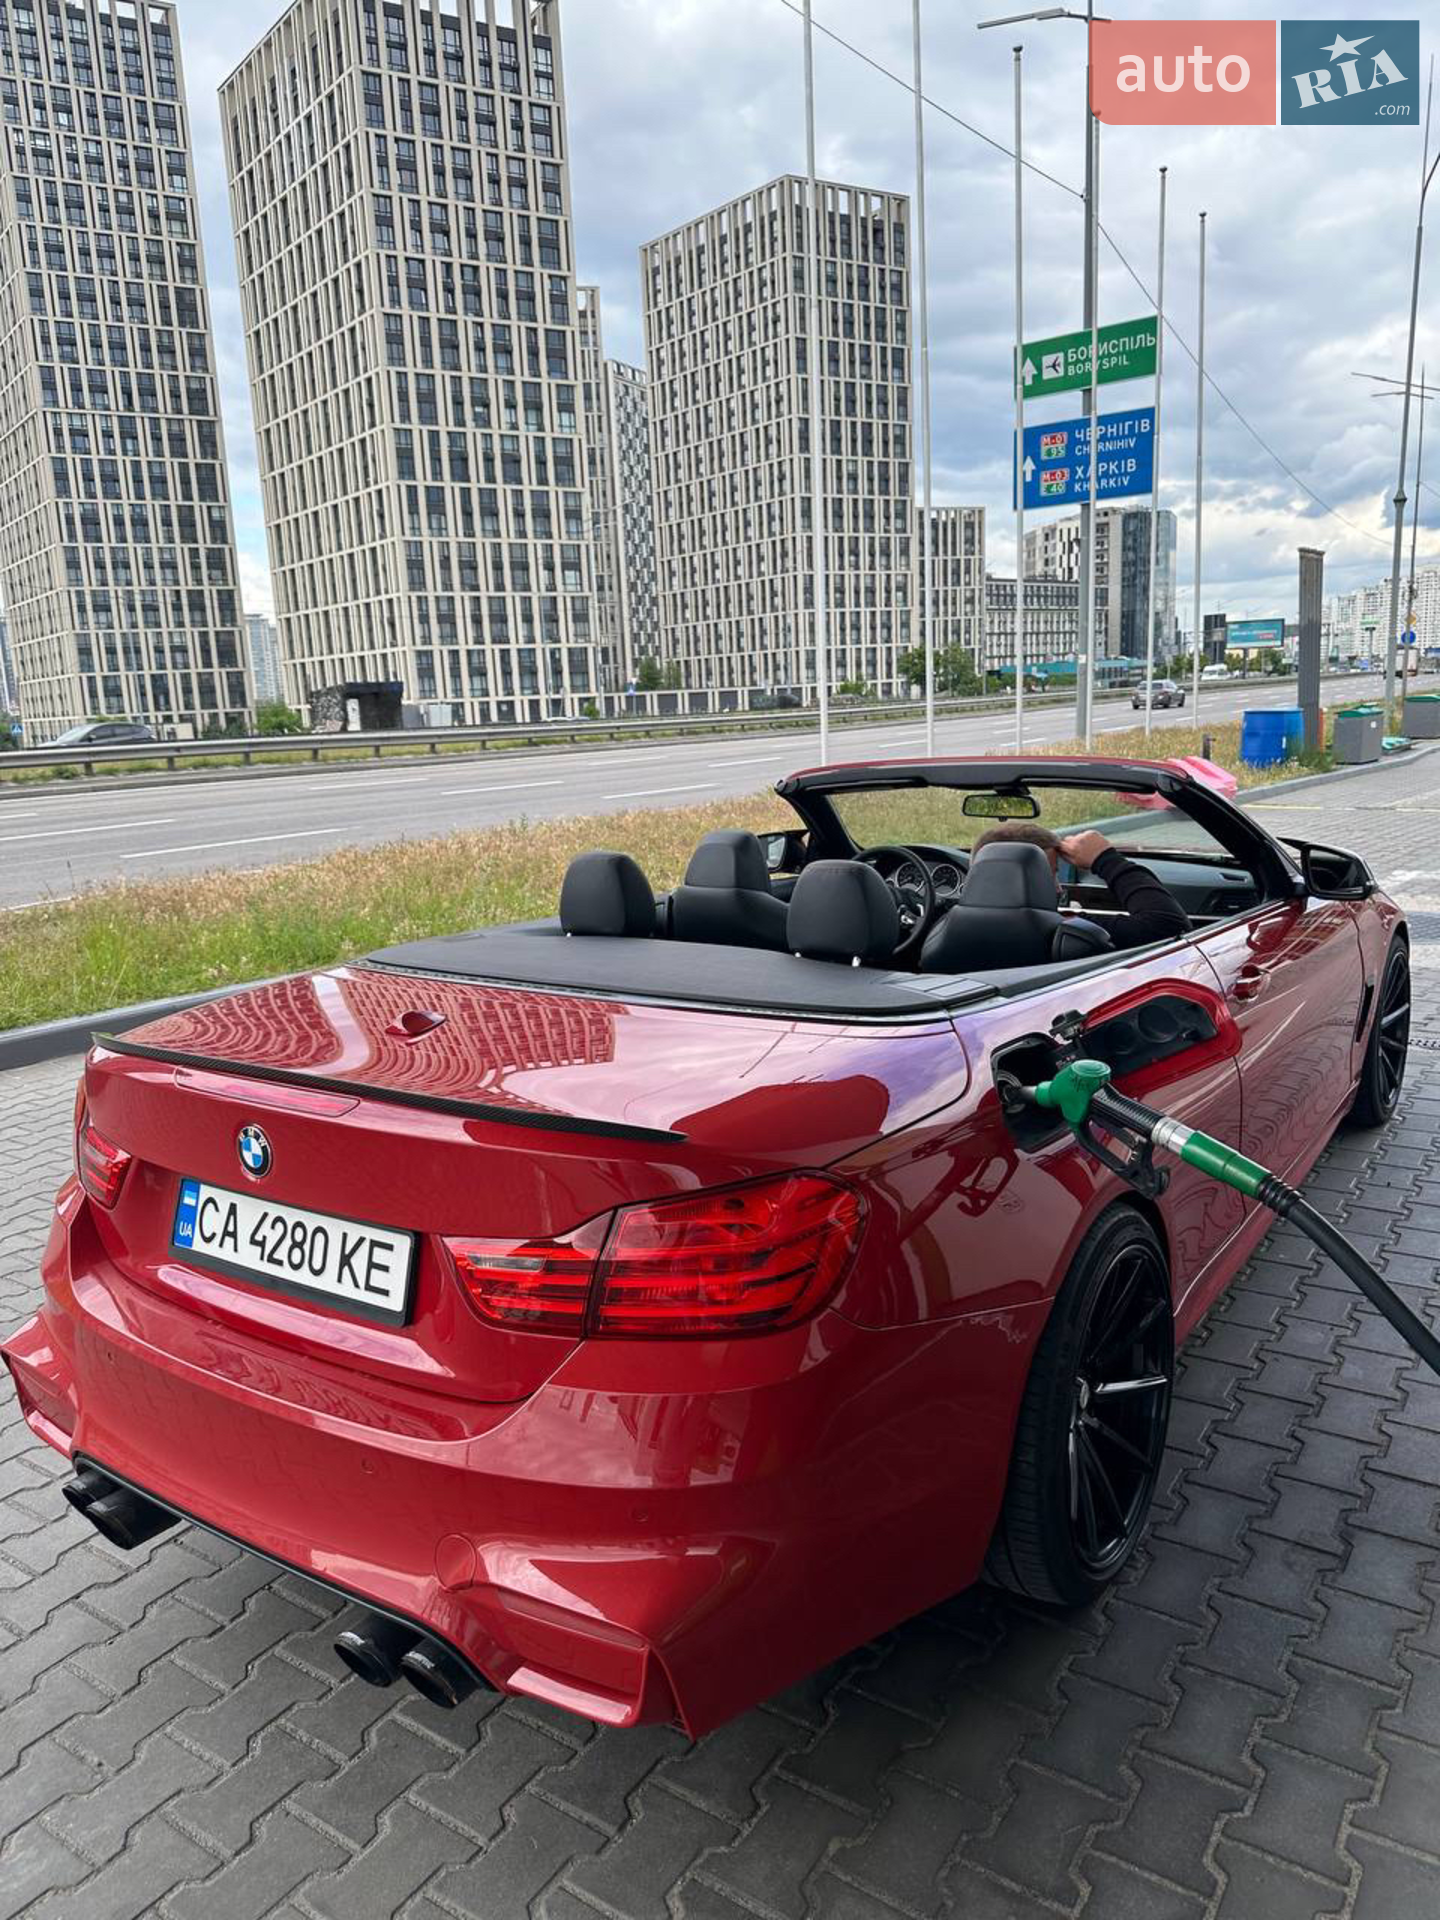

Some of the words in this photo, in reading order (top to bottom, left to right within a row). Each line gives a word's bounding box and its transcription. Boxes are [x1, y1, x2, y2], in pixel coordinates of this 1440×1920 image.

[1075, 437, 1137, 456] CHRNIHIV
[179, 1221, 193, 1238] UA
[199, 1196, 239, 1253] CA
[249, 1211, 330, 1277] 4280
[337, 1231, 395, 1298] KE
